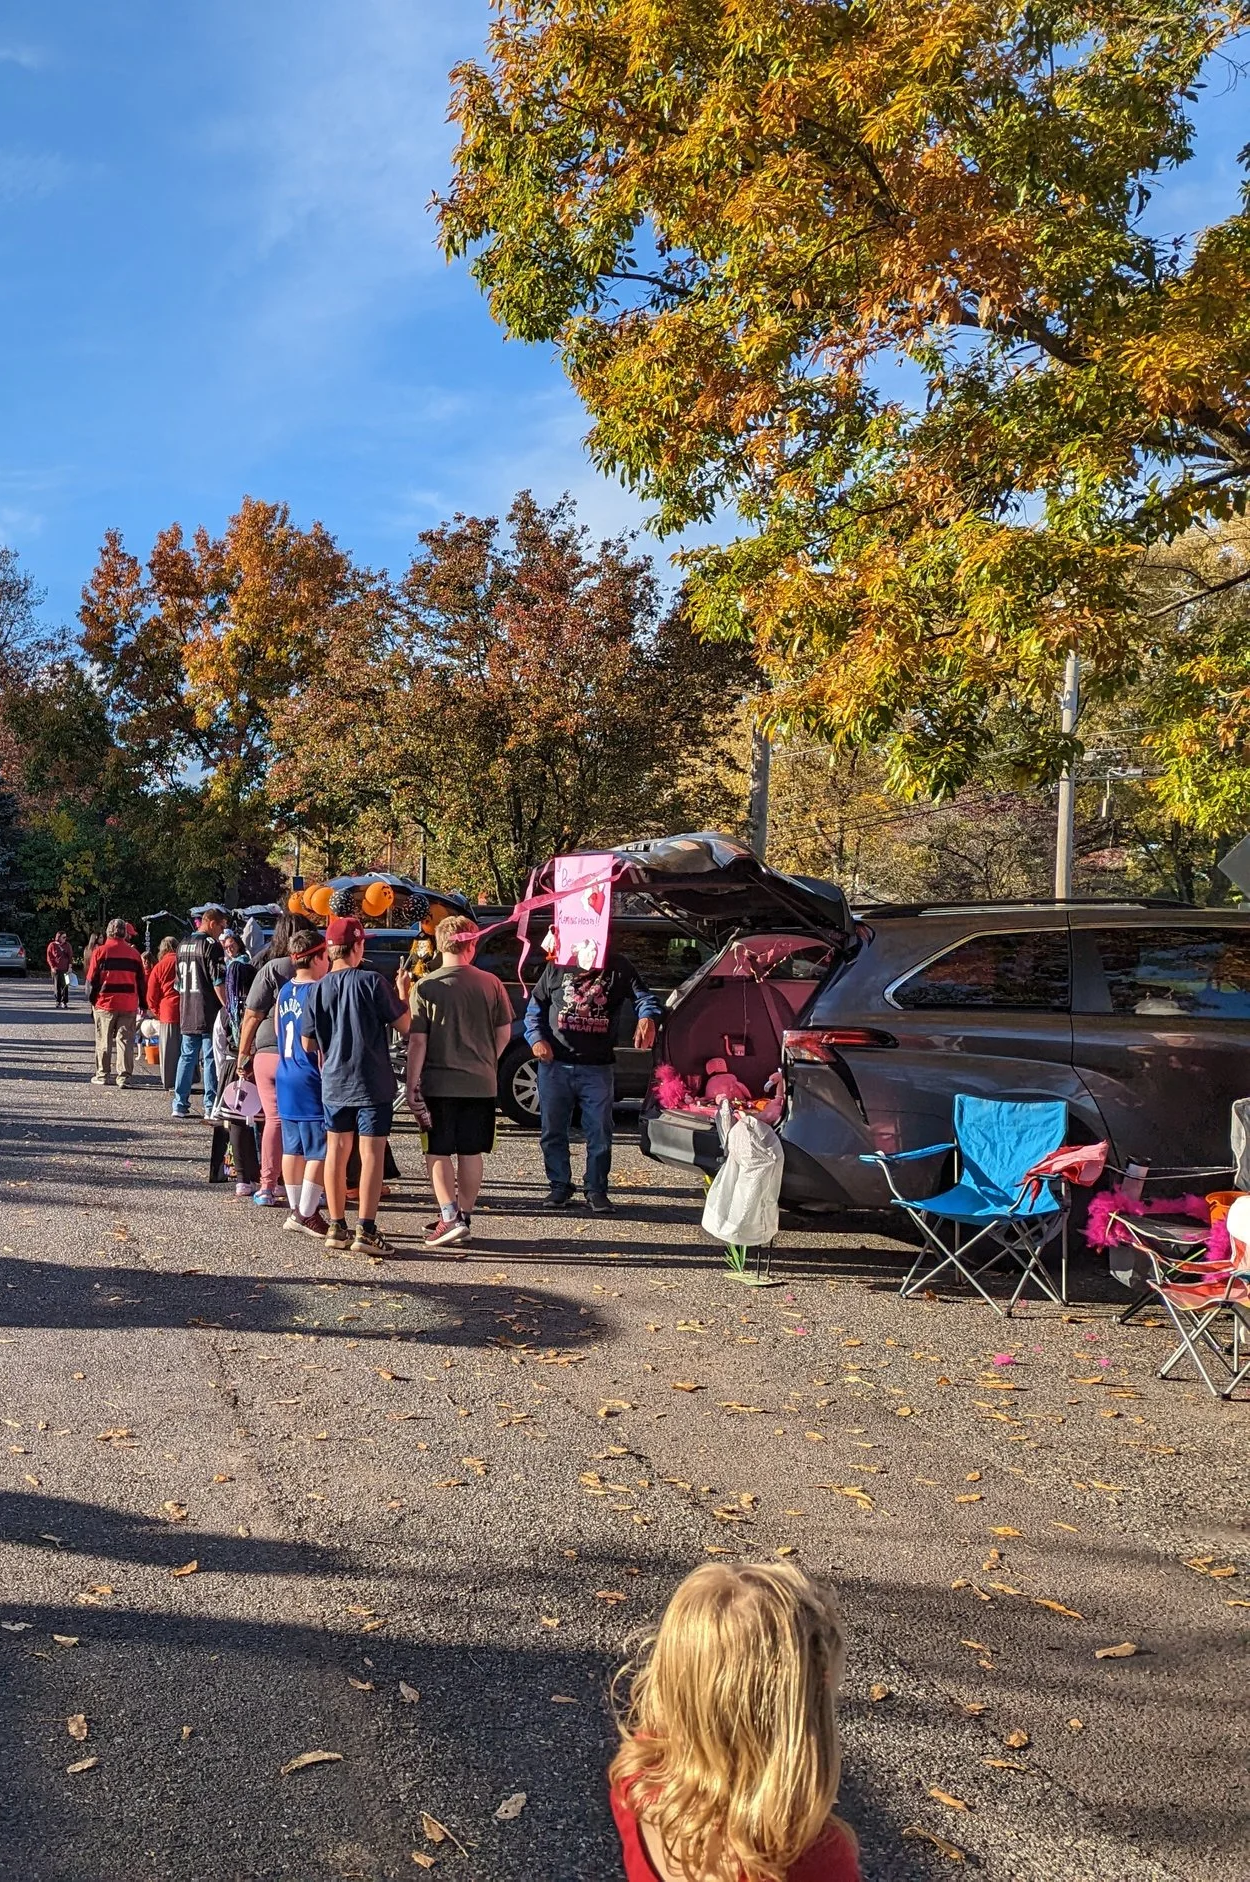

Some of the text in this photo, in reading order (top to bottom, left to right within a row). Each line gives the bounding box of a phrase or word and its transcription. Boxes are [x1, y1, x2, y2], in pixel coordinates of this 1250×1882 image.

[279, 997, 302, 1020] HARDEN
[567, 1015, 610, 1027] OCTOBER
[569, 1023, 591, 1032] WEAR
[284, 1020, 294, 1058] 1
